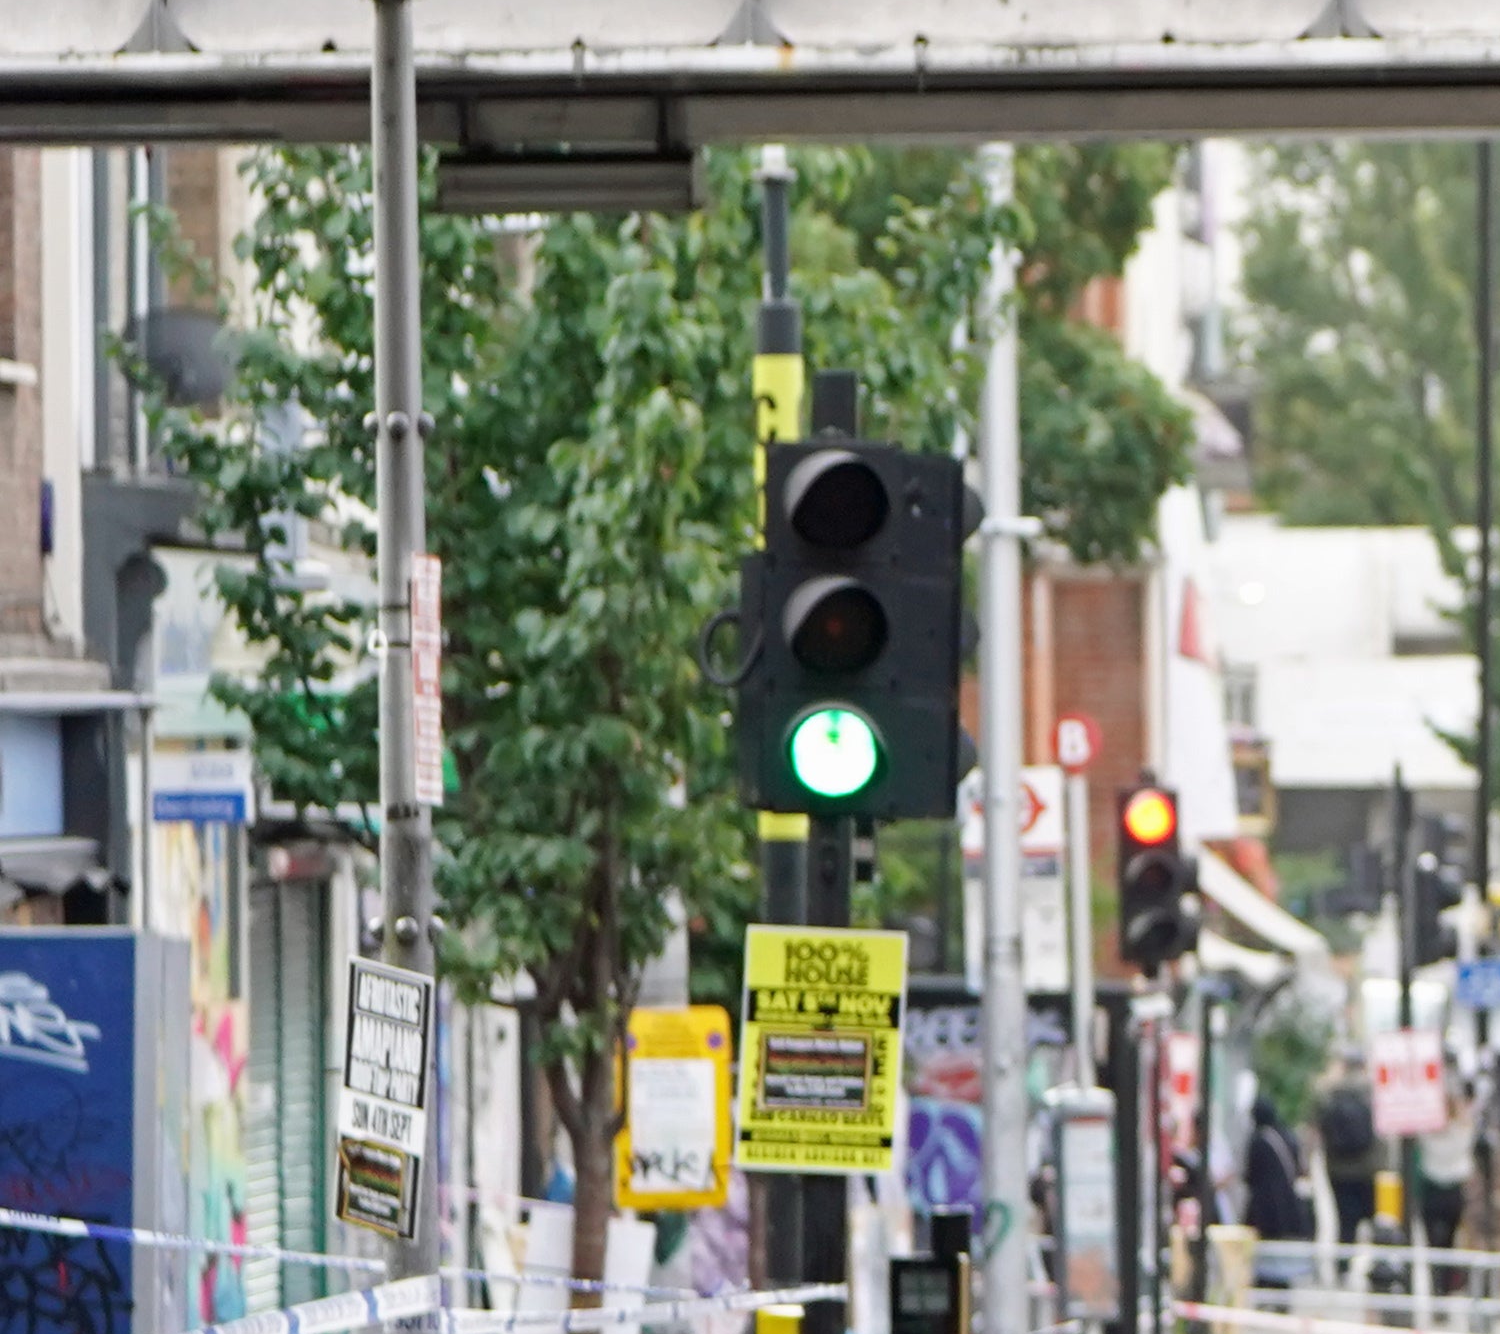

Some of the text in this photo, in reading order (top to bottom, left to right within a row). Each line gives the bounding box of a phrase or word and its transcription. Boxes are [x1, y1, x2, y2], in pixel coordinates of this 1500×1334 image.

[784, 938, 870, 963] 100%
[784, 961, 869, 985] HOUSE
[839, 992, 891, 1016] NOV
[352, 1098, 369, 1130] SUN
[390, 1109, 412, 1145] SEPT
